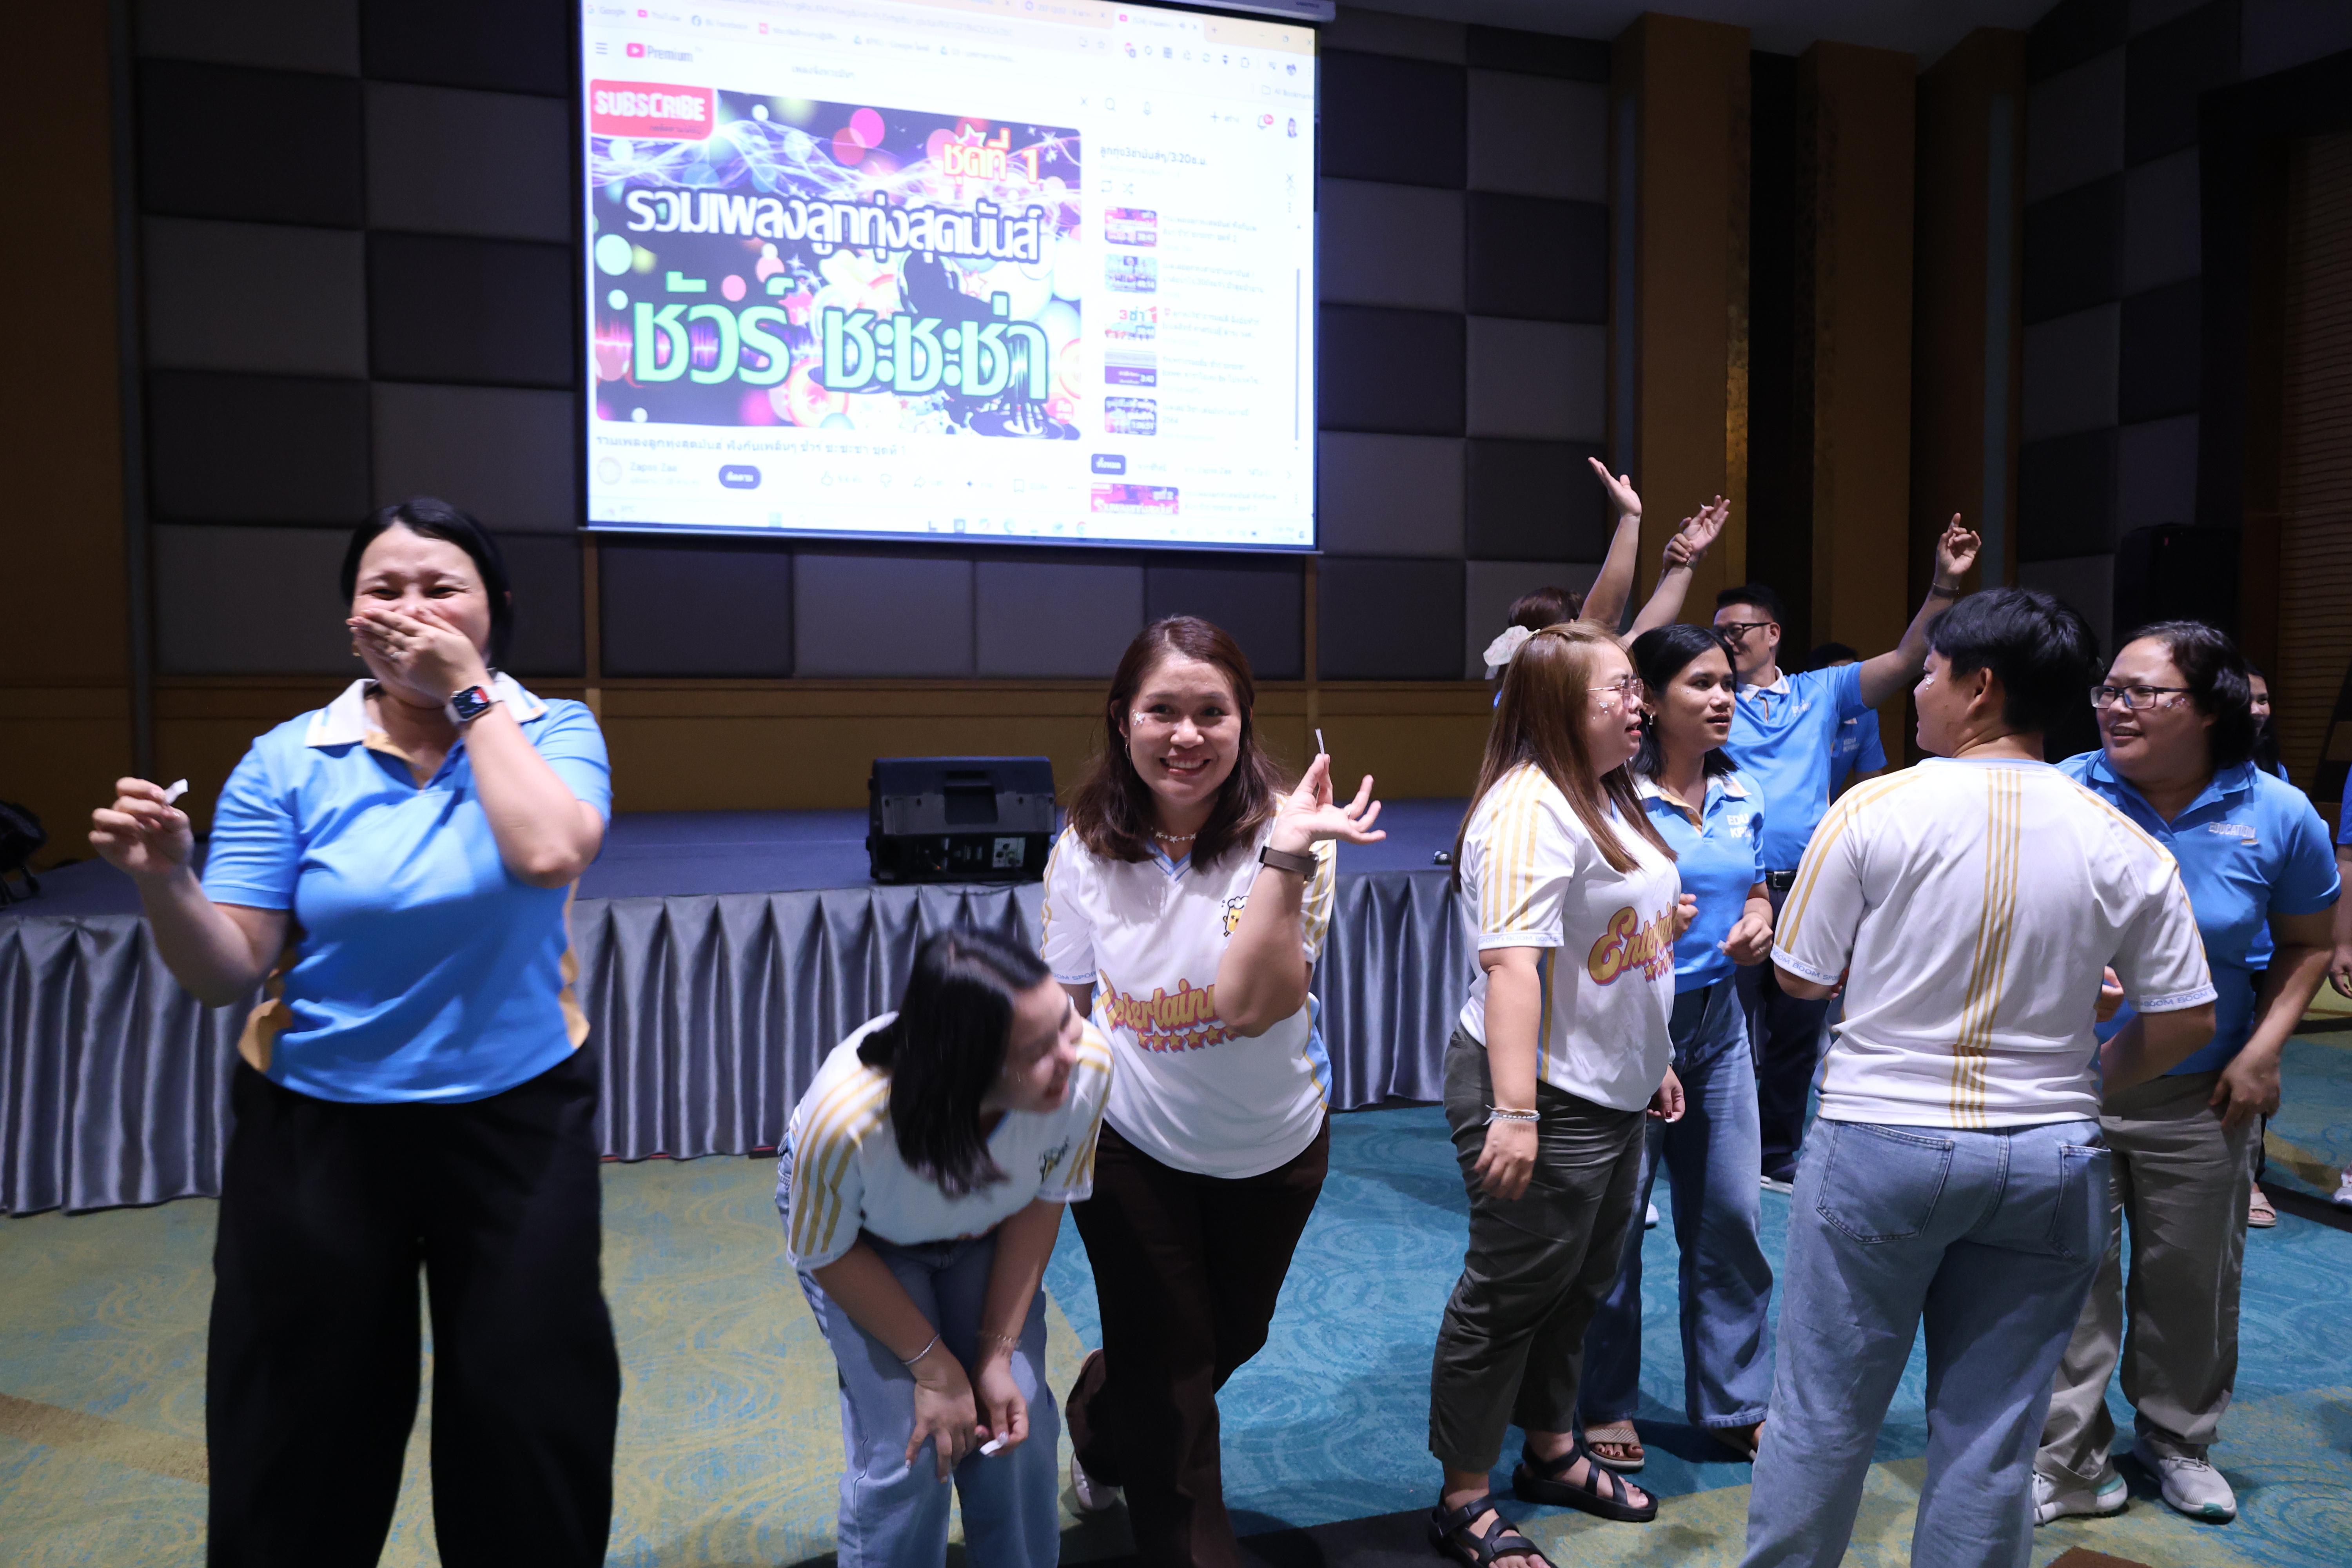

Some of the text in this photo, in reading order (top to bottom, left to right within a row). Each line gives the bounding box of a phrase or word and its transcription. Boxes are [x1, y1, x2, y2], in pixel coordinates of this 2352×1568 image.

[647, 44, 693, 63] Premium
[594, 90, 706, 121] SUBSCRIBE
[944, 127, 1038, 187] ชุดที่ 1
[626, 190, 1044, 263] รวมเพลงลูกทุ่งสุดมันส์
[633, 270, 1048, 400] ชัวร์ ชะชะช่า
[1726, 813, 1750, 826] EDU
[1072, 971, 1096, 980] SPOR
[1792, 962, 1820, 978] BOOM
[2177, 991, 2208, 1003] BOOM
